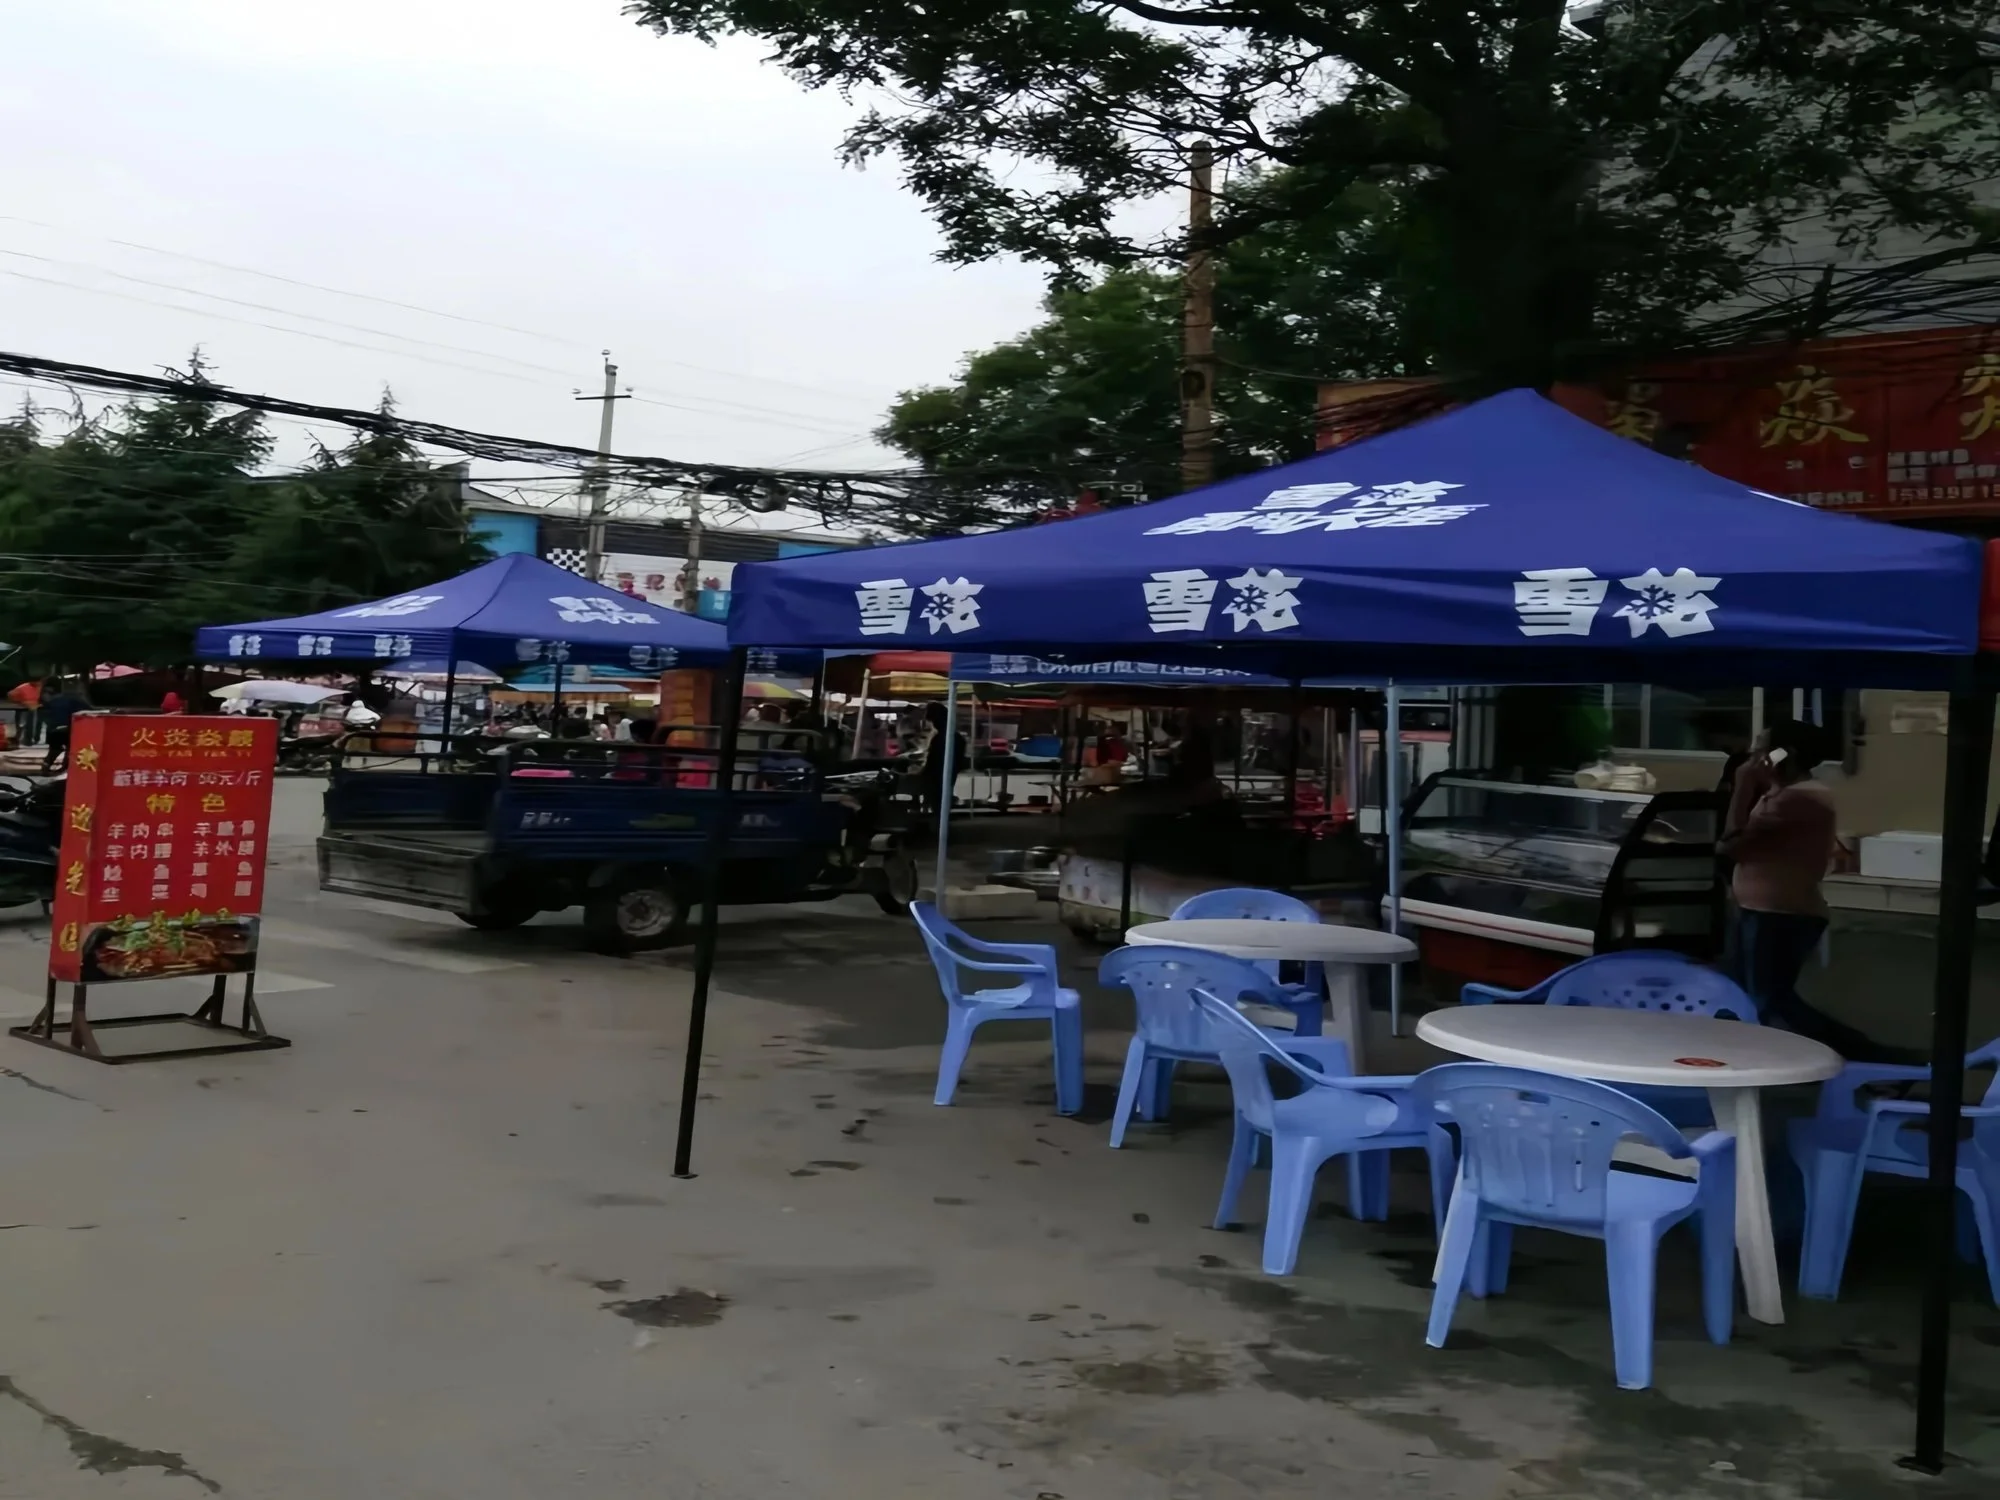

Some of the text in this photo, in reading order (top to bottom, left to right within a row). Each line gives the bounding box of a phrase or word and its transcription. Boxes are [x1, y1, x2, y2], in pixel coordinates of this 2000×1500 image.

[855, 577, 985, 636] 雪花
[1142, 567, 1304, 634] 雪花
[1513, 567, 1723, 637] 雪花
[146, 793, 228, 815] 特色
